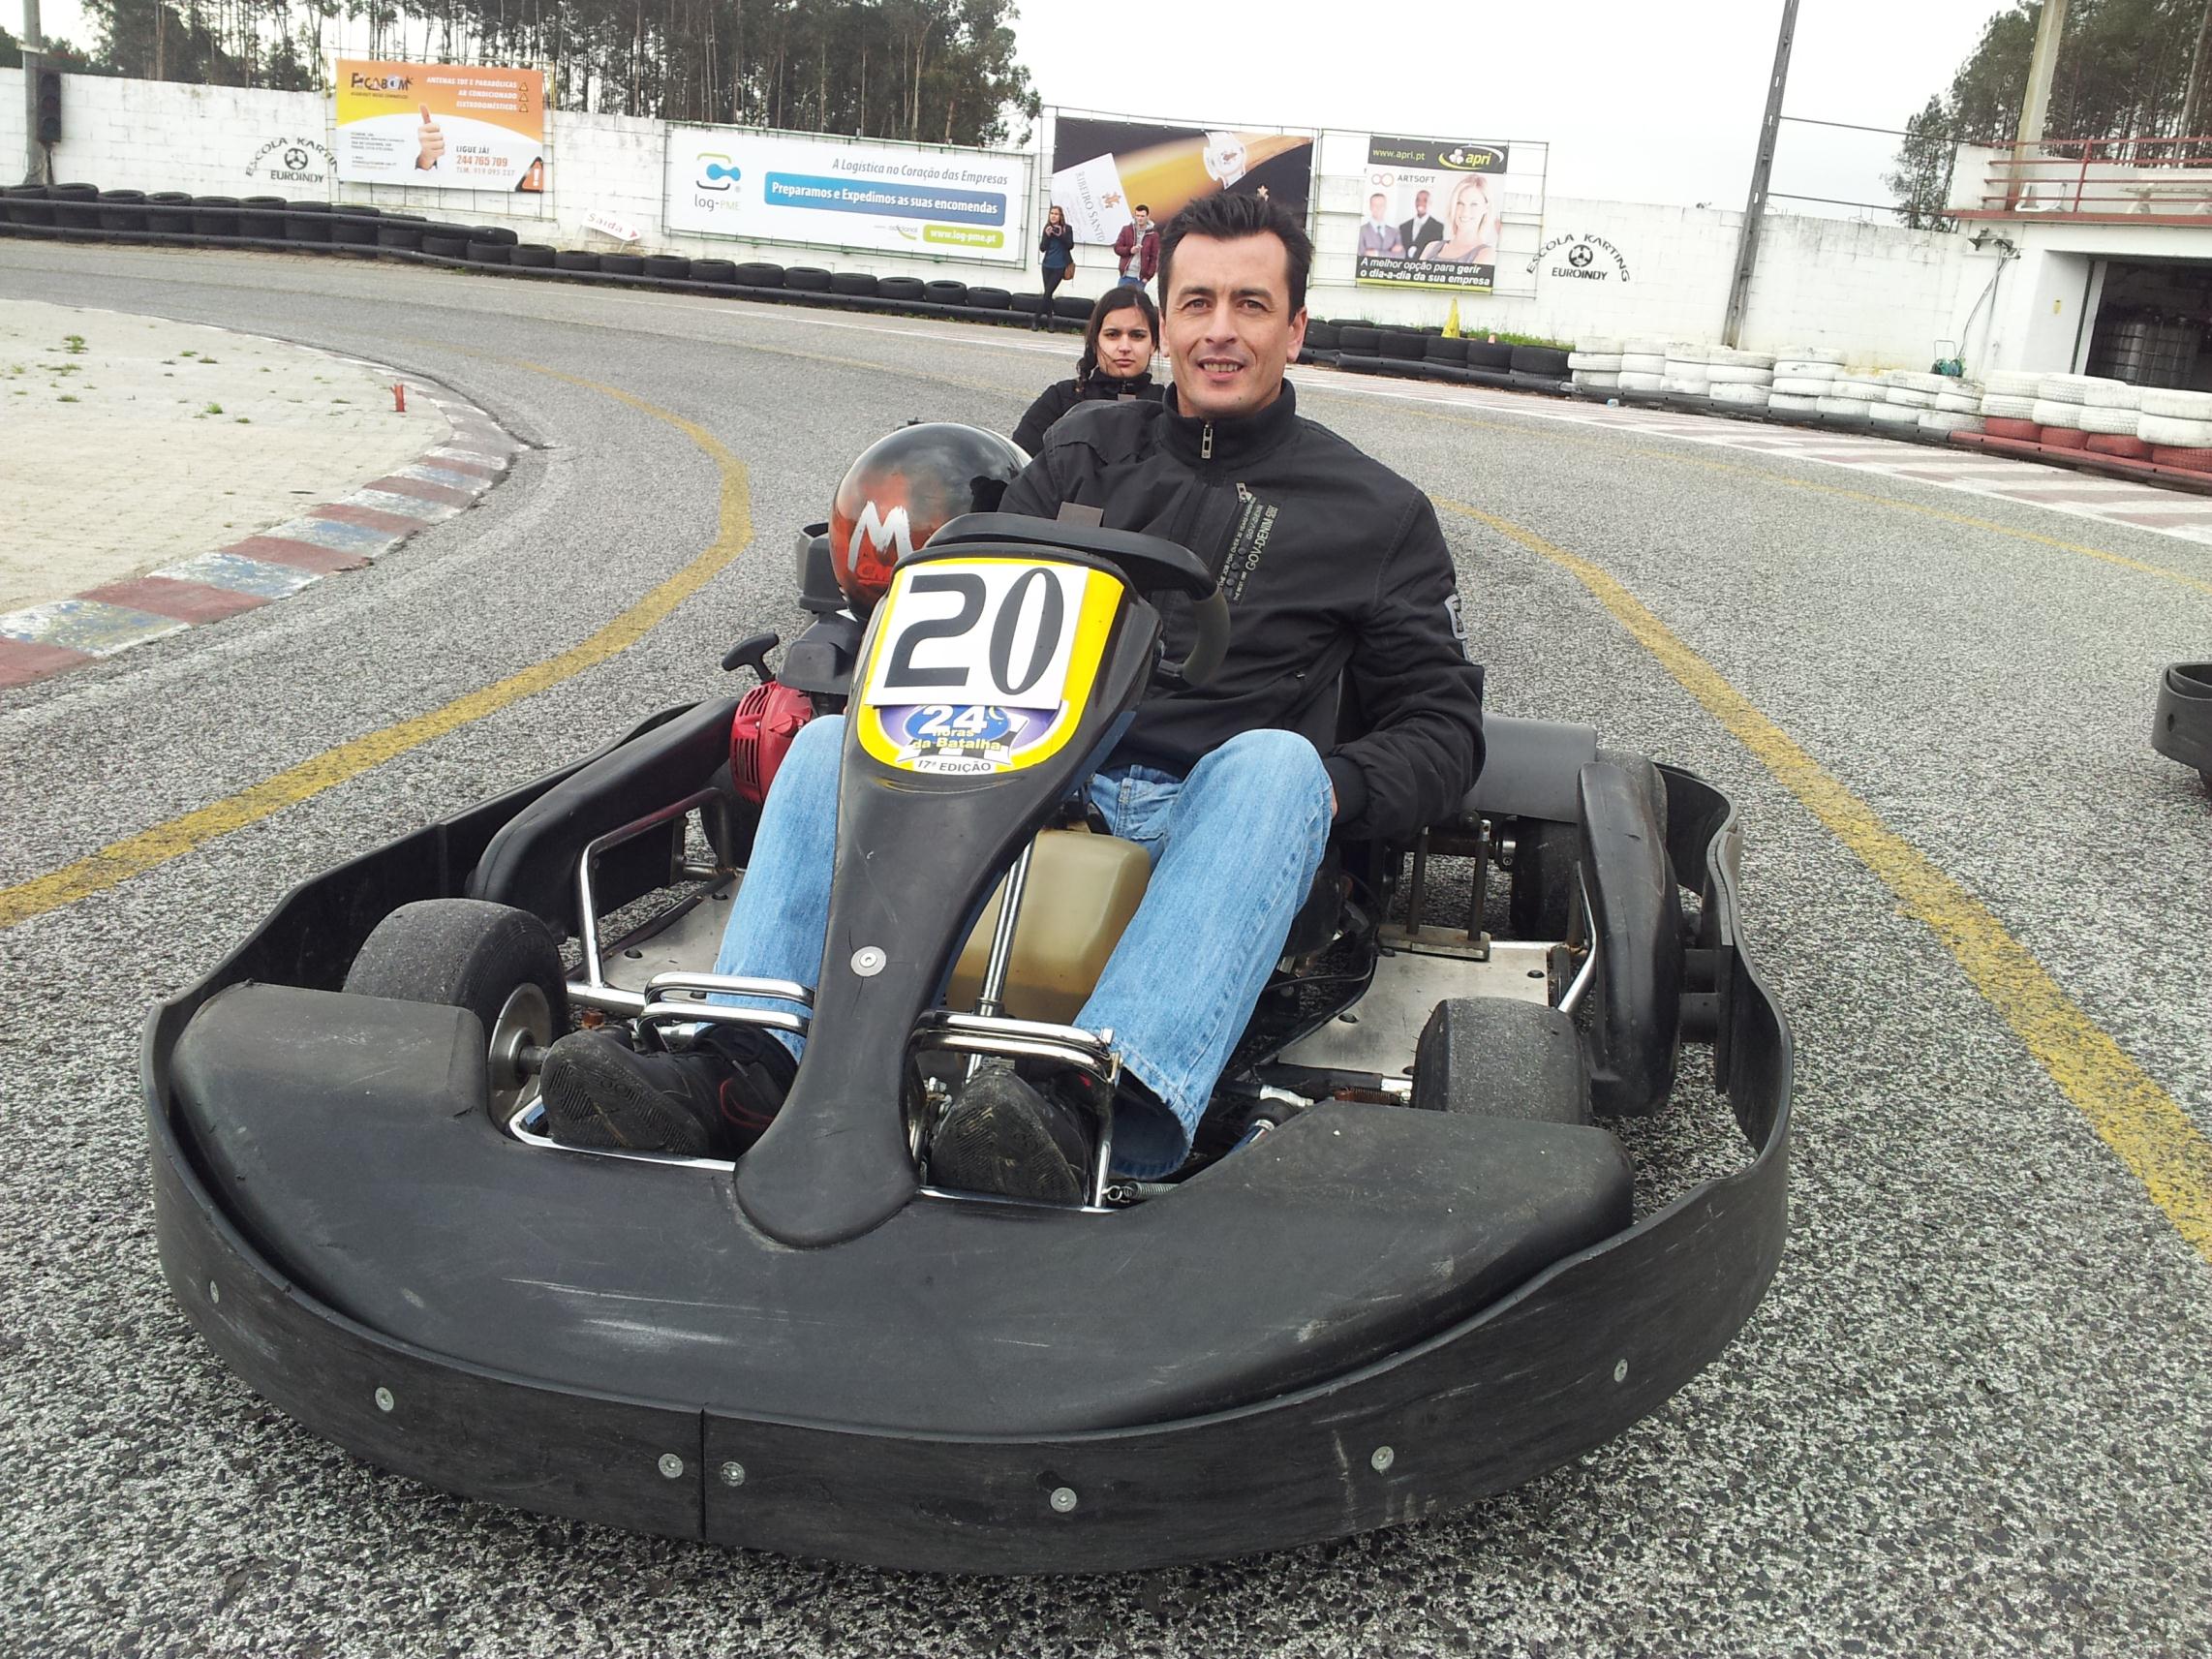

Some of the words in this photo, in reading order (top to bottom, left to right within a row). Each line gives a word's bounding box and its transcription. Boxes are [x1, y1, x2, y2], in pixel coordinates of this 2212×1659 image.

[246, 137, 289, 177] ESCOLA
[296, 137, 338, 173] KARTIN
[456, 155, 473, 165] 244
[475, 156, 490, 166] 765
[492, 157, 508, 167] 709
[1372, 148, 1426, 161] www.apri.pt
[1465, 152, 1492, 167] apri
[270, 169, 324, 183] EUROINDY
[832, 158, 840, 169] A
[886, 165, 899, 175] no
[901, 164, 939, 180] Coração
[941, 168, 959, 181] das
[961, 169, 1008, 186] Empresas
[1398, 173, 1435, 184] ARTSOFT
[772, 181, 832, 199] Preparamos
[834, 189, 841, 199] e
[842, 188, 896, 204] Expedimos
[897, 196, 908, 206] as
[910, 198, 933, 208] suas
[935, 200, 998, 214] encomendas
[1361, 257, 1367, 266] A
[1369, 258, 1401, 269] melhor
[1403, 261, 1432, 272] opção
[1433, 263, 1455, 274] para
[1457, 264, 1481, 276] gerir
[1526, 233, 1575, 274] ESCOLA
[1583, 233, 1630, 282] KARTING
[1360, 269, 1367, 278] o
[1368, 269, 1411, 280] dia-a-dia
[1413, 271, 1426, 281] da
[1428, 274, 1446, 283] sua
[1448, 275, 1490, 286] empresa
[1551, 266, 1609, 281] EUROINDY
[847, 501, 913, 572] M
[1245, 518, 1274, 570] GOV-DENIM
[883, 567, 1064, 695] 20
[918, 705, 987, 734] 24
[912, 738, 931, 751] da
[936, 737, 1001, 753] Batalha
[939, 760, 992, 775] EDIÇÃO
